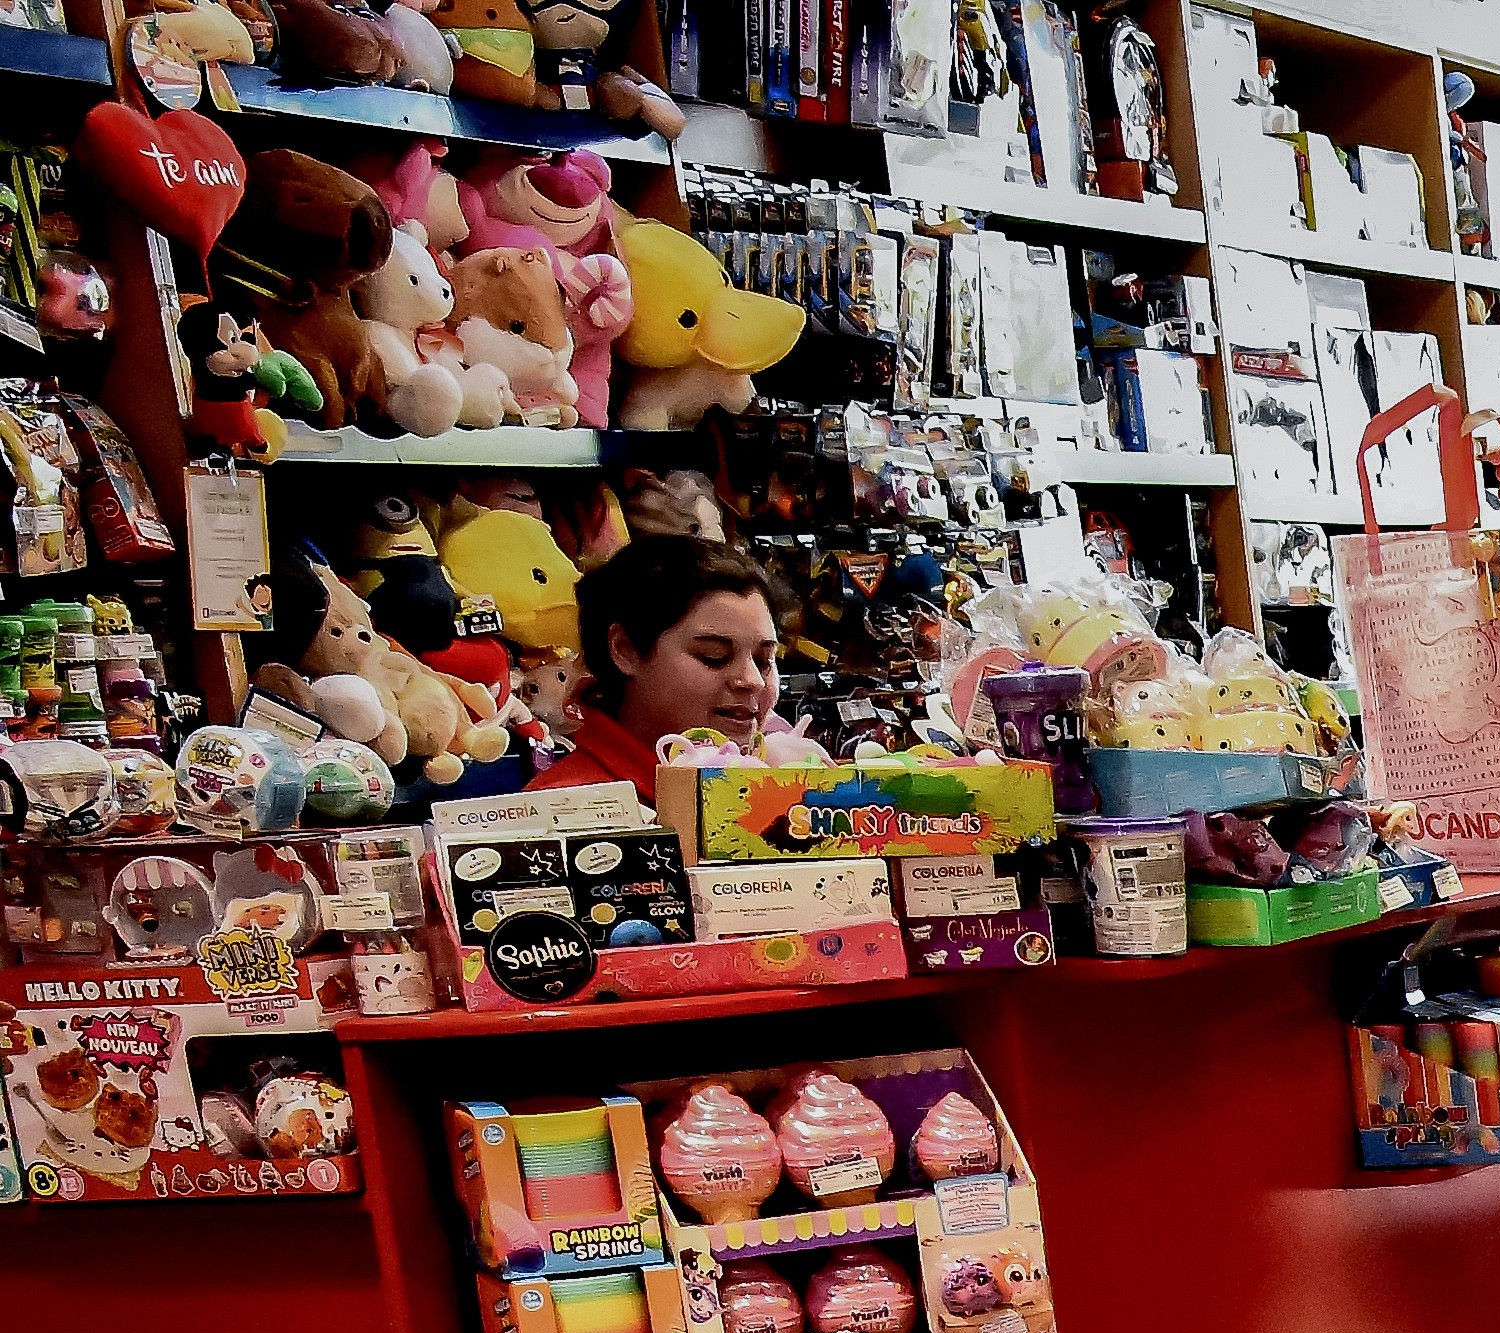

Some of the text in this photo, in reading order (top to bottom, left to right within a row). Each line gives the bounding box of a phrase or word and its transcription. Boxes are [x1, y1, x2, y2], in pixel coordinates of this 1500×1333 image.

[138, 142, 188, 189] te
[787, 804, 981, 841] SHAKY friends
[650, 905, 687, 917] GLOW
[208, 937, 280, 971] MINI
[496, 936, 584, 970] Sophie
[221, 960, 282, 987] VERSE
[25, 976, 181, 1003] HELLO KITTY
[106, 1023, 139, 1038] NEW
[250, 1012, 279, 1024] FOOD
[88, 1037, 159, 1057] NOUVEAU
[552, 1224, 641, 1253] RAINBOW
[575, 1238, 643, 1261] SPRING
